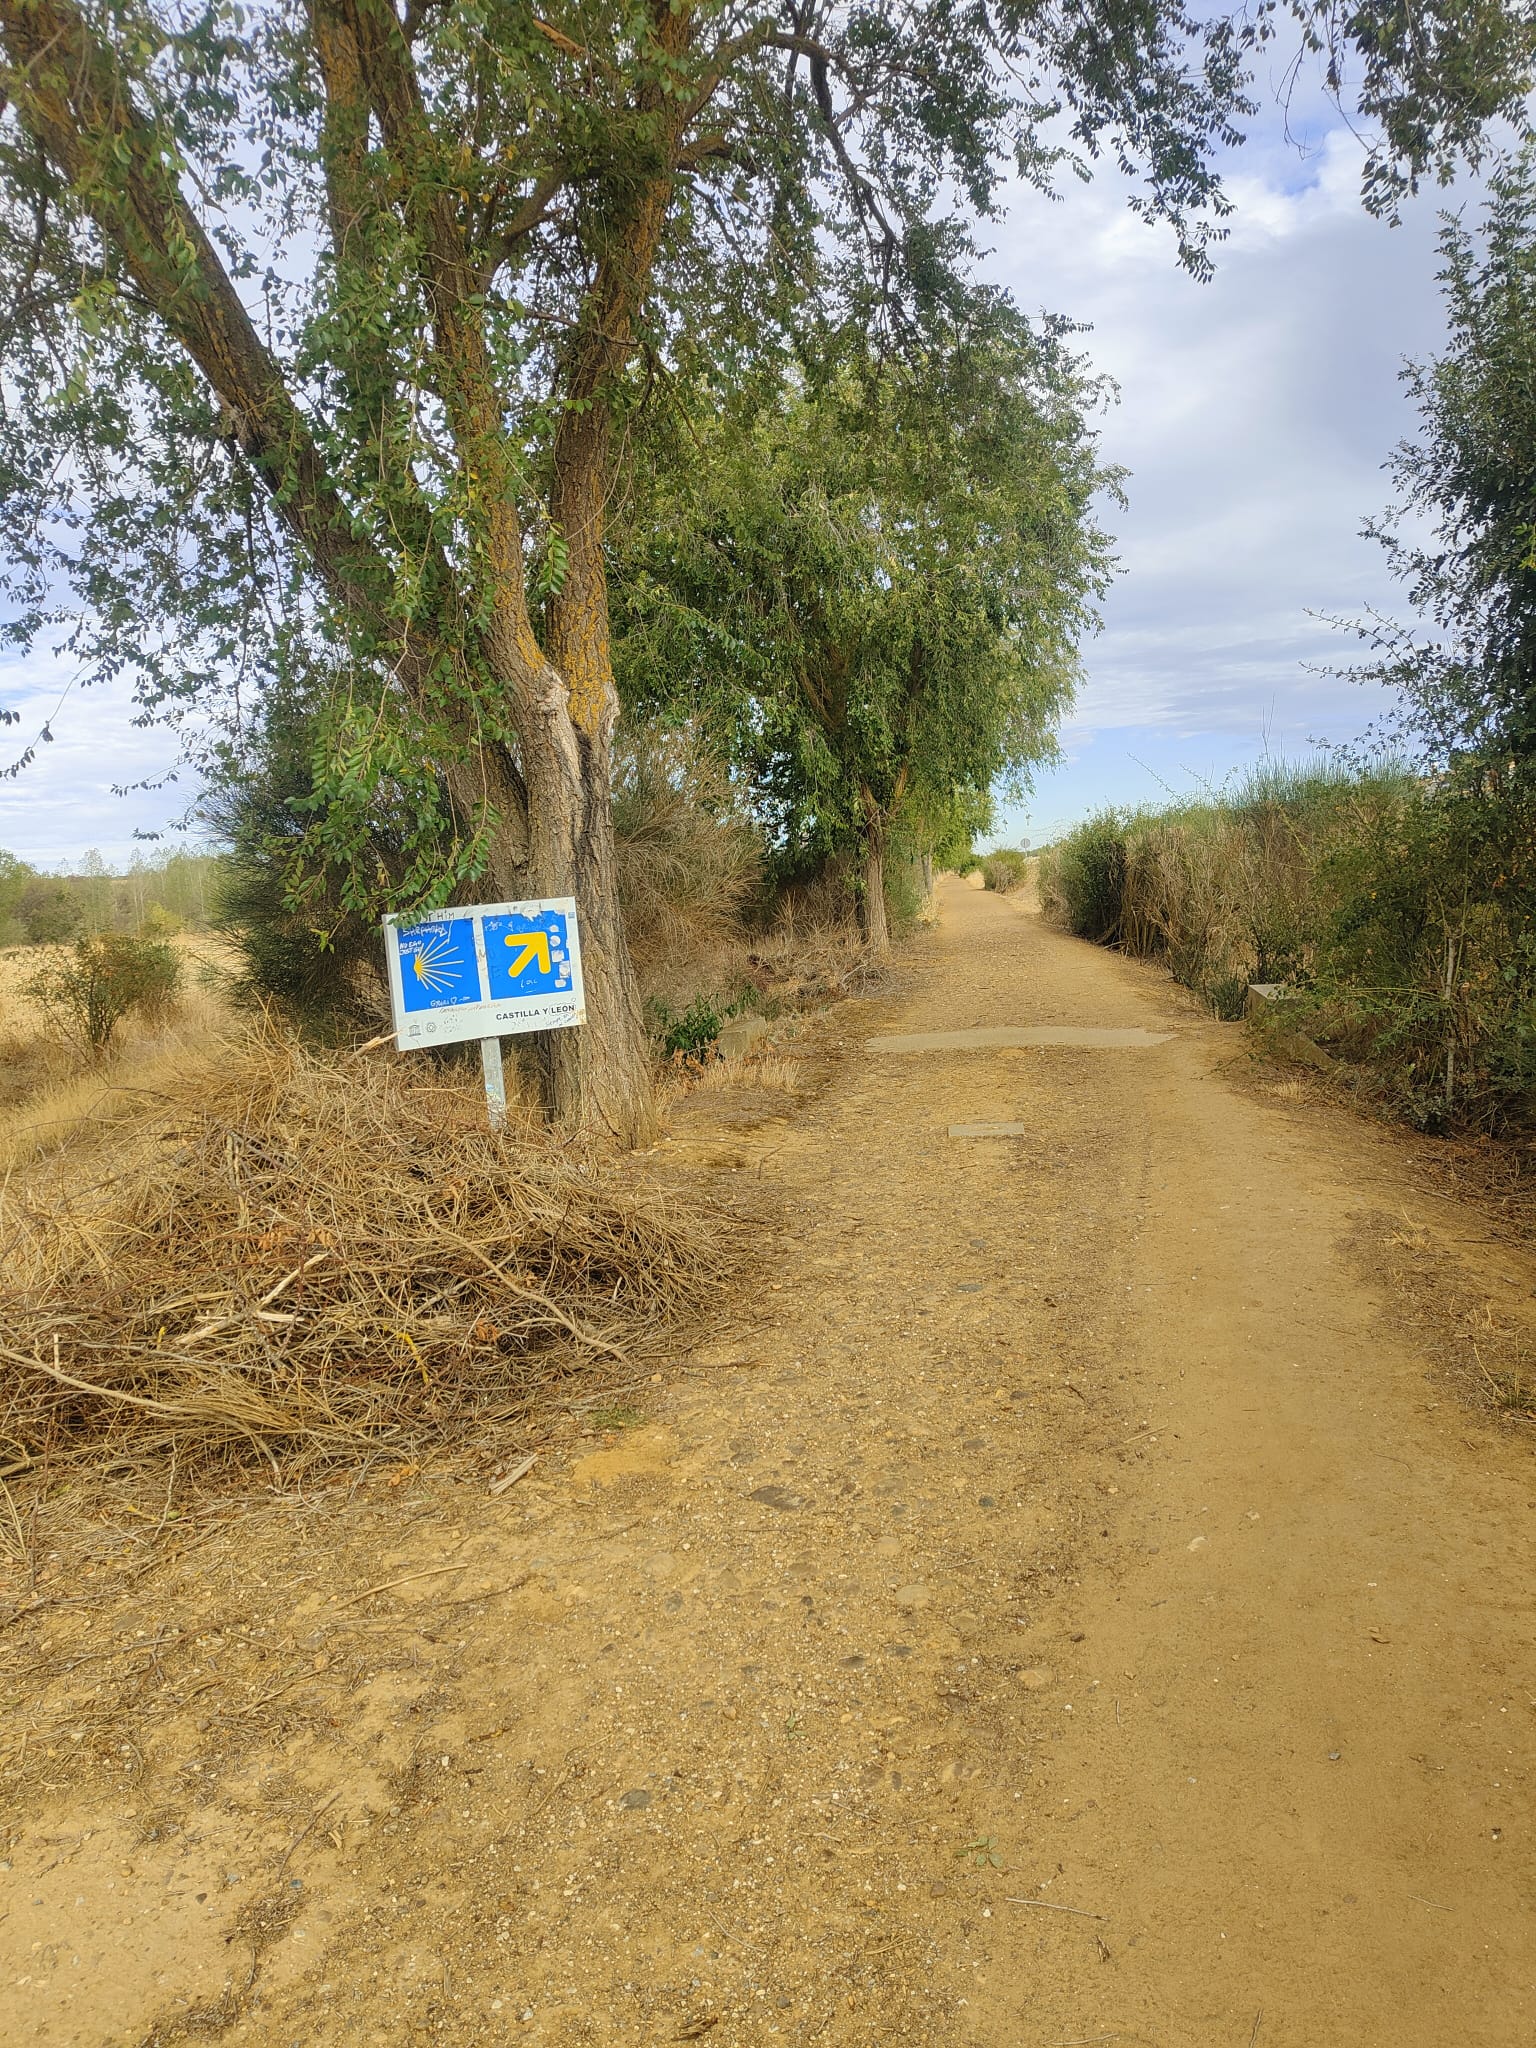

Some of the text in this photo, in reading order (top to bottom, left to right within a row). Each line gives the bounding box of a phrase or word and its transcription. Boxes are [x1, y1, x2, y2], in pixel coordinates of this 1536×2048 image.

[496, 1005, 575, 1021] CASTILLA Y LEON
